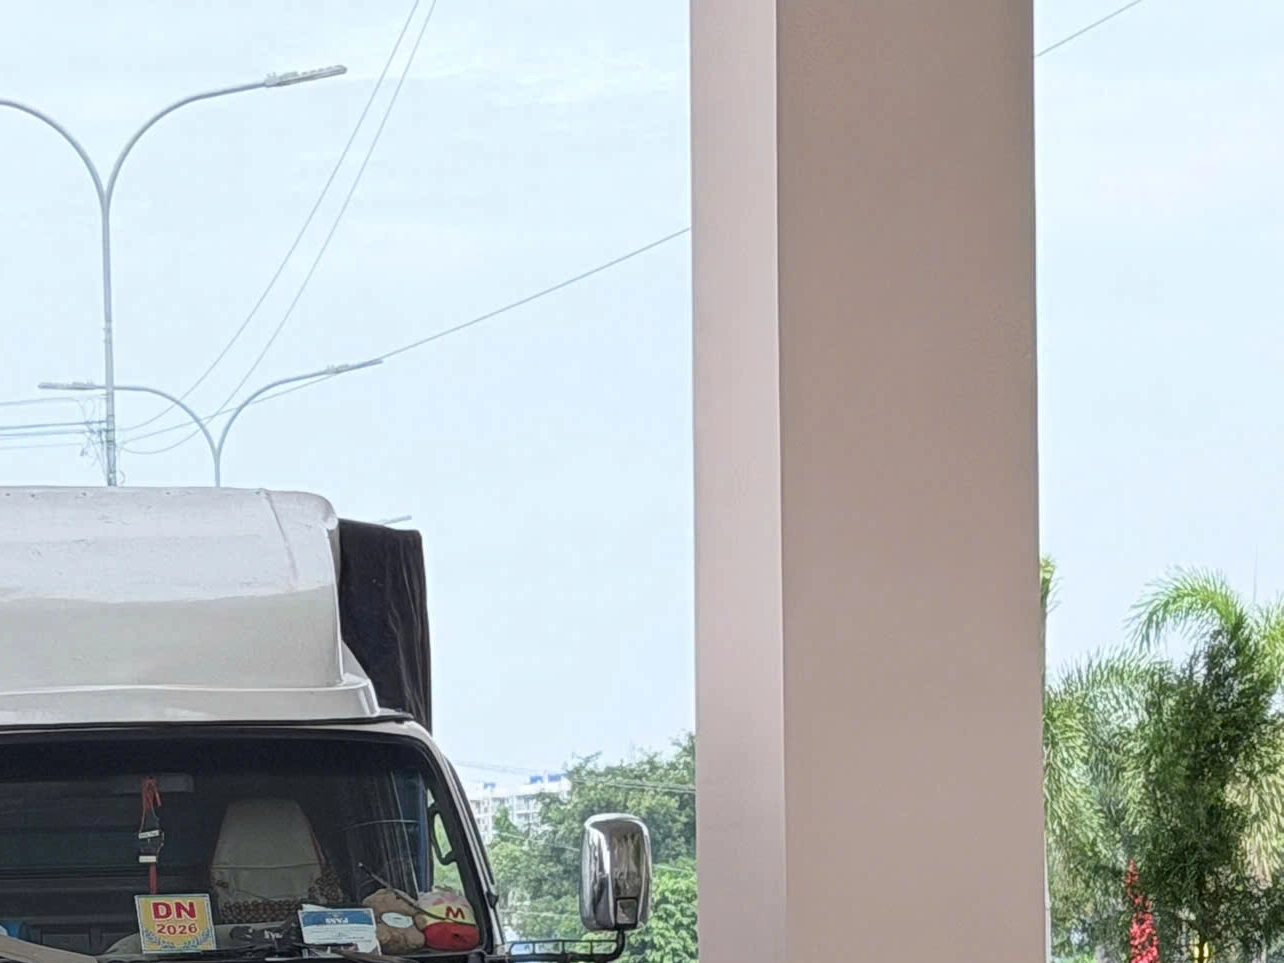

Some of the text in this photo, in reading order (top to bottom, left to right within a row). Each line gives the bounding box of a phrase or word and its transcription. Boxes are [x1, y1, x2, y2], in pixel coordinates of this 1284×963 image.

[152, 902, 196, 919] DN
[445, 906, 465, 919] M
[156, 923, 197, 935] 2026
